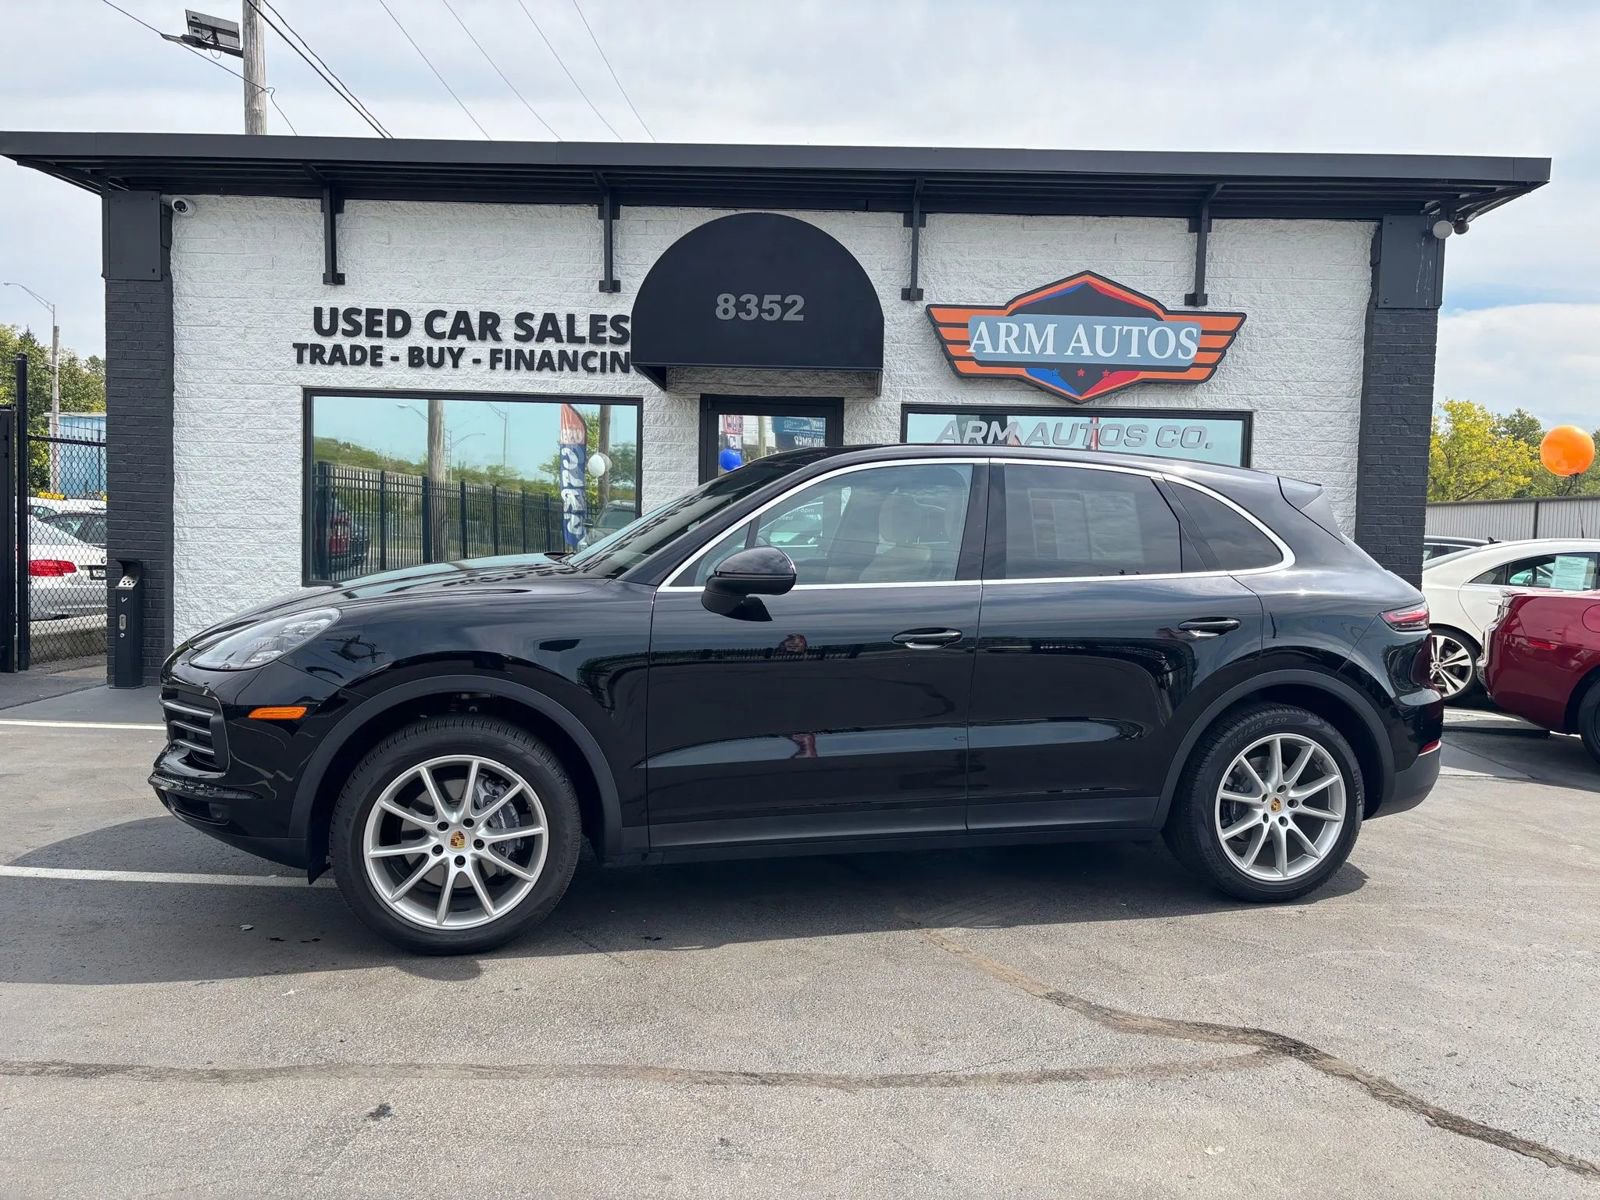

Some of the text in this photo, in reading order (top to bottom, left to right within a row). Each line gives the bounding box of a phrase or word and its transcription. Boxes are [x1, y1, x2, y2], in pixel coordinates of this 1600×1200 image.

[715, 293, 805, 321] 8352
[314, 307, 630, 345] USED CAR SALES
[966, 321, 1198, 360] ARM AUTOS
[292, 343, 383, 366] TRADE
[408, 346, 467, 369] BUY
[489, 348, 630, 373] FINANCIN
[935, 420, 1213, 449] ARM AUTOS CO.
